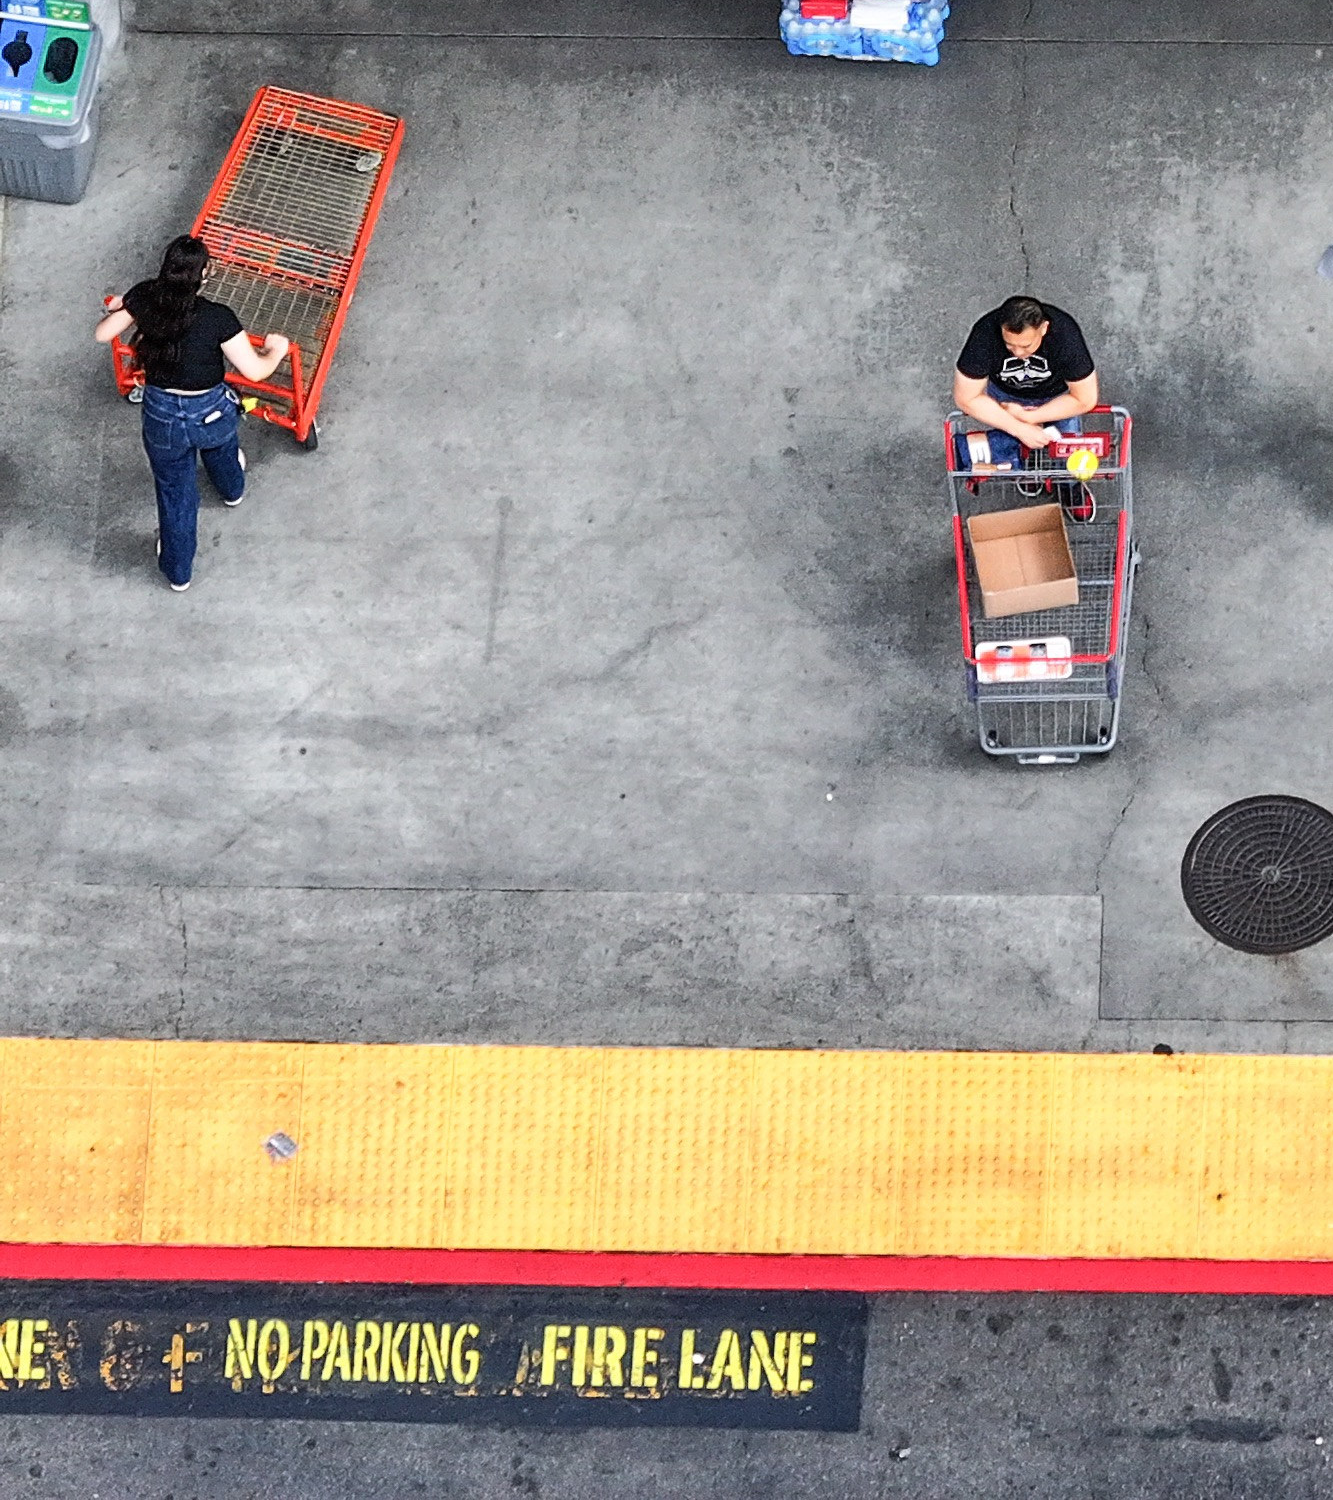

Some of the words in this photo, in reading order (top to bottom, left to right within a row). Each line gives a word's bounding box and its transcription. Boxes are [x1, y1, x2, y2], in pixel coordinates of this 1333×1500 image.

[225, 1318, 290, 1381] NO
[301, 1320, 480, 1384] PARKING
[541, 1325, 662, 1387] FIRE
[678, 1329, 817, 1392] LANE
